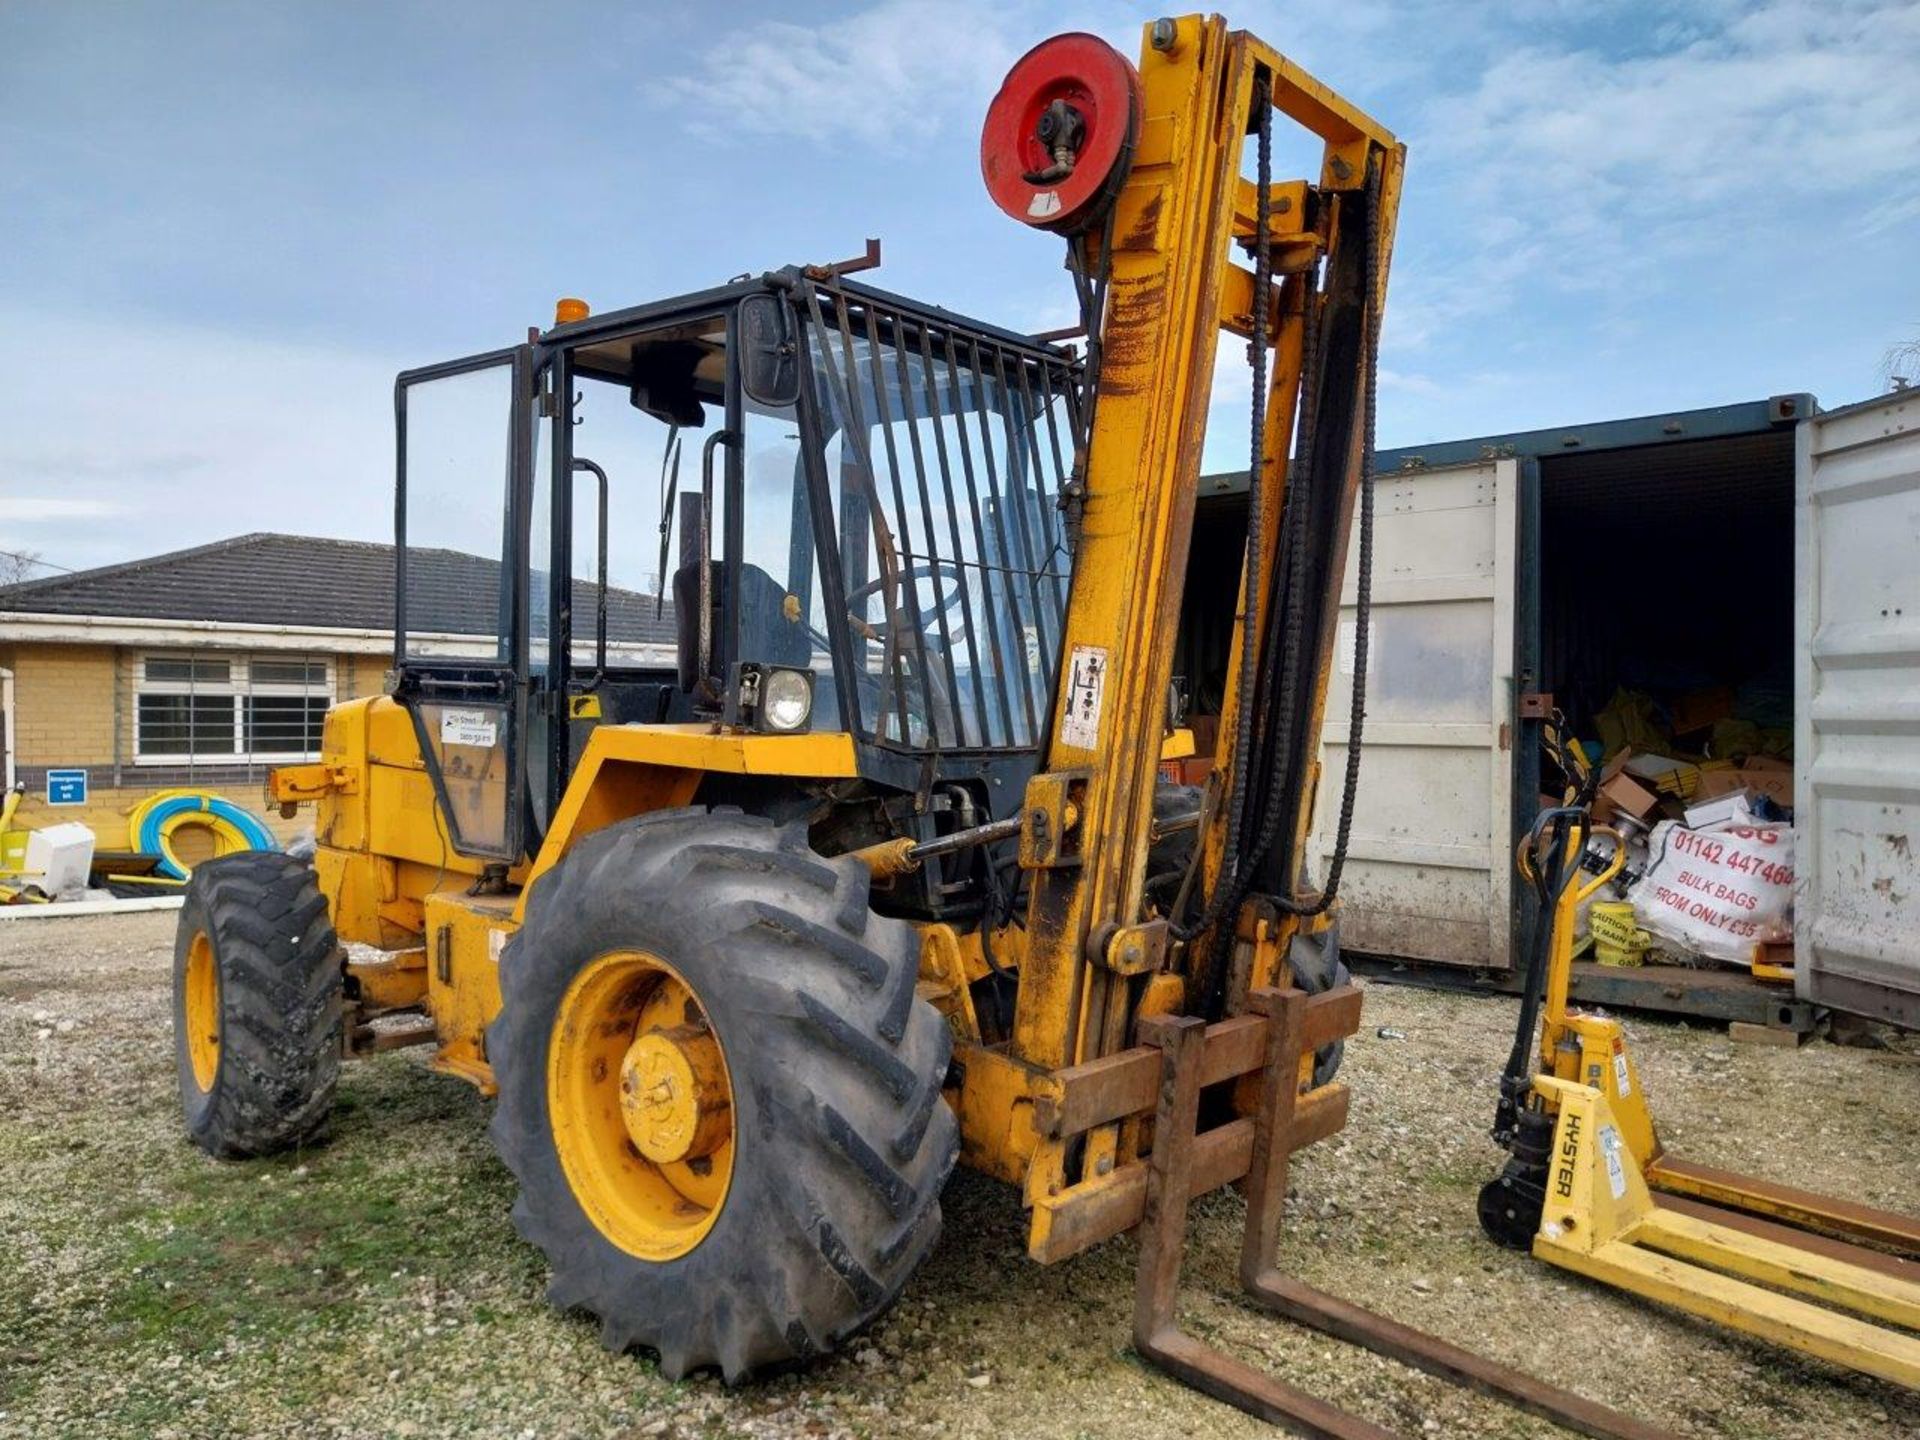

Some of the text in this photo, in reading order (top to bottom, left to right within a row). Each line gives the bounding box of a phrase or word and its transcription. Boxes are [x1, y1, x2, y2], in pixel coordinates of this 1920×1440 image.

[1675, 831, 1723, 865] 01142
[1678, 871, 1758, 910] BULK BAGS
[1656, 886, 1757, 938] FROM ONLY £35
[1601, 929, 1627, 944] MAIN
[1557, 1113, 1581, 1197] HYSTER
